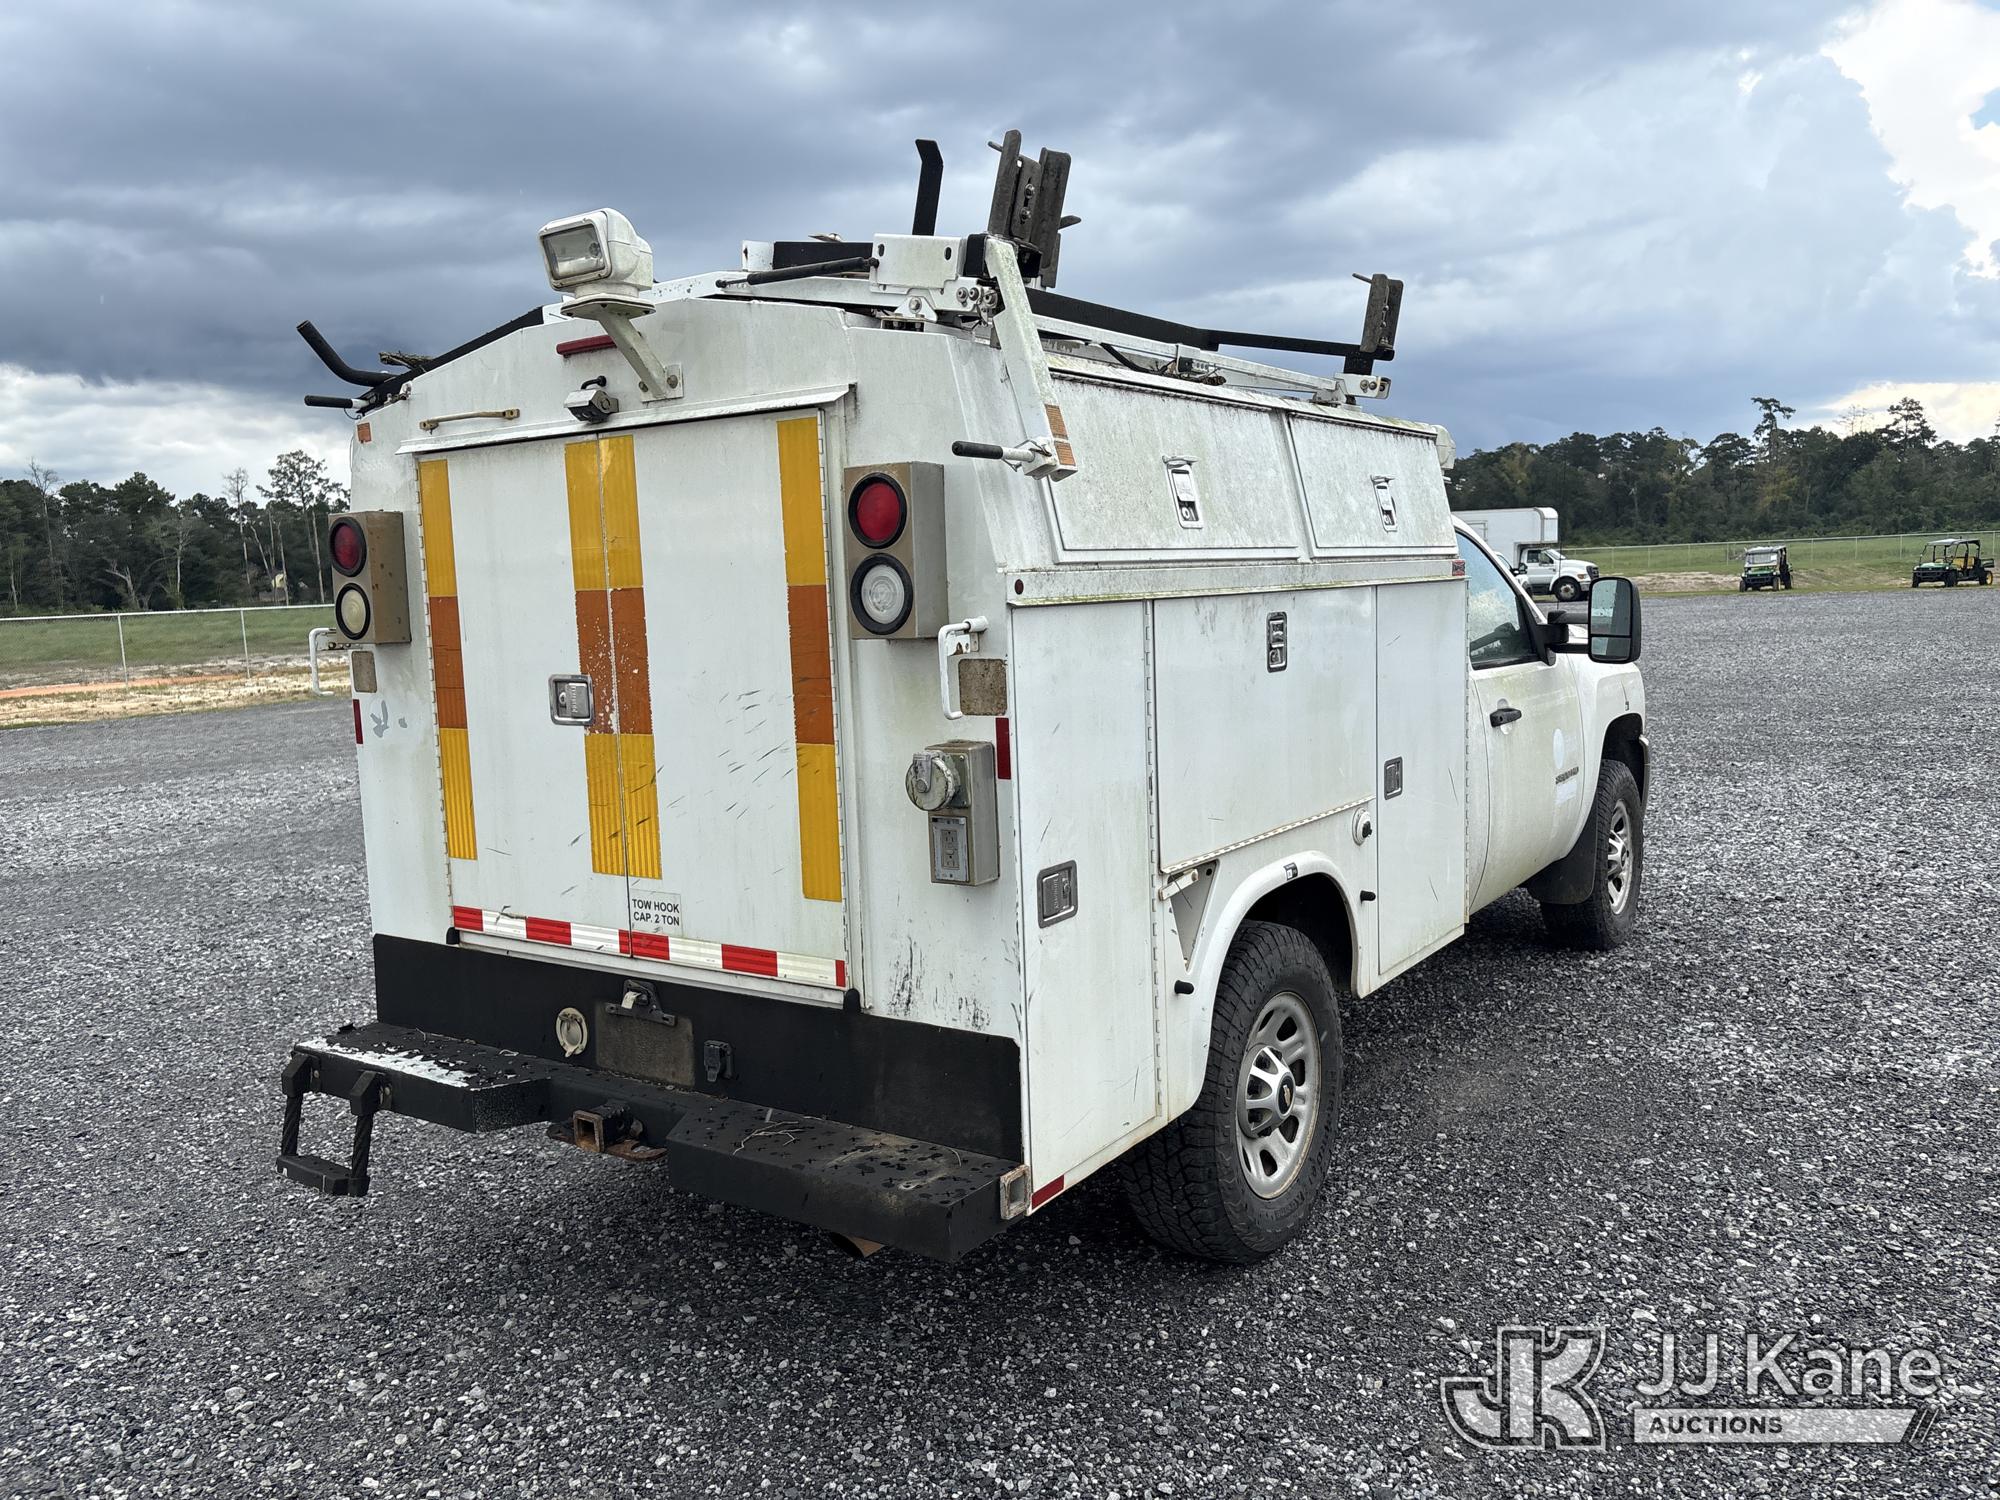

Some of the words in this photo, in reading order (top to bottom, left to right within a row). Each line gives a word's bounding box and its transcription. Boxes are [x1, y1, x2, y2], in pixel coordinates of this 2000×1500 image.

[632, 899, 652, 910] TOW
[654, 902, 680, 913] HOOK
[633, 911, 652, 922] CAP.
[654, 914, 660, 923] 2
[661, 915, 680, 926] TON
